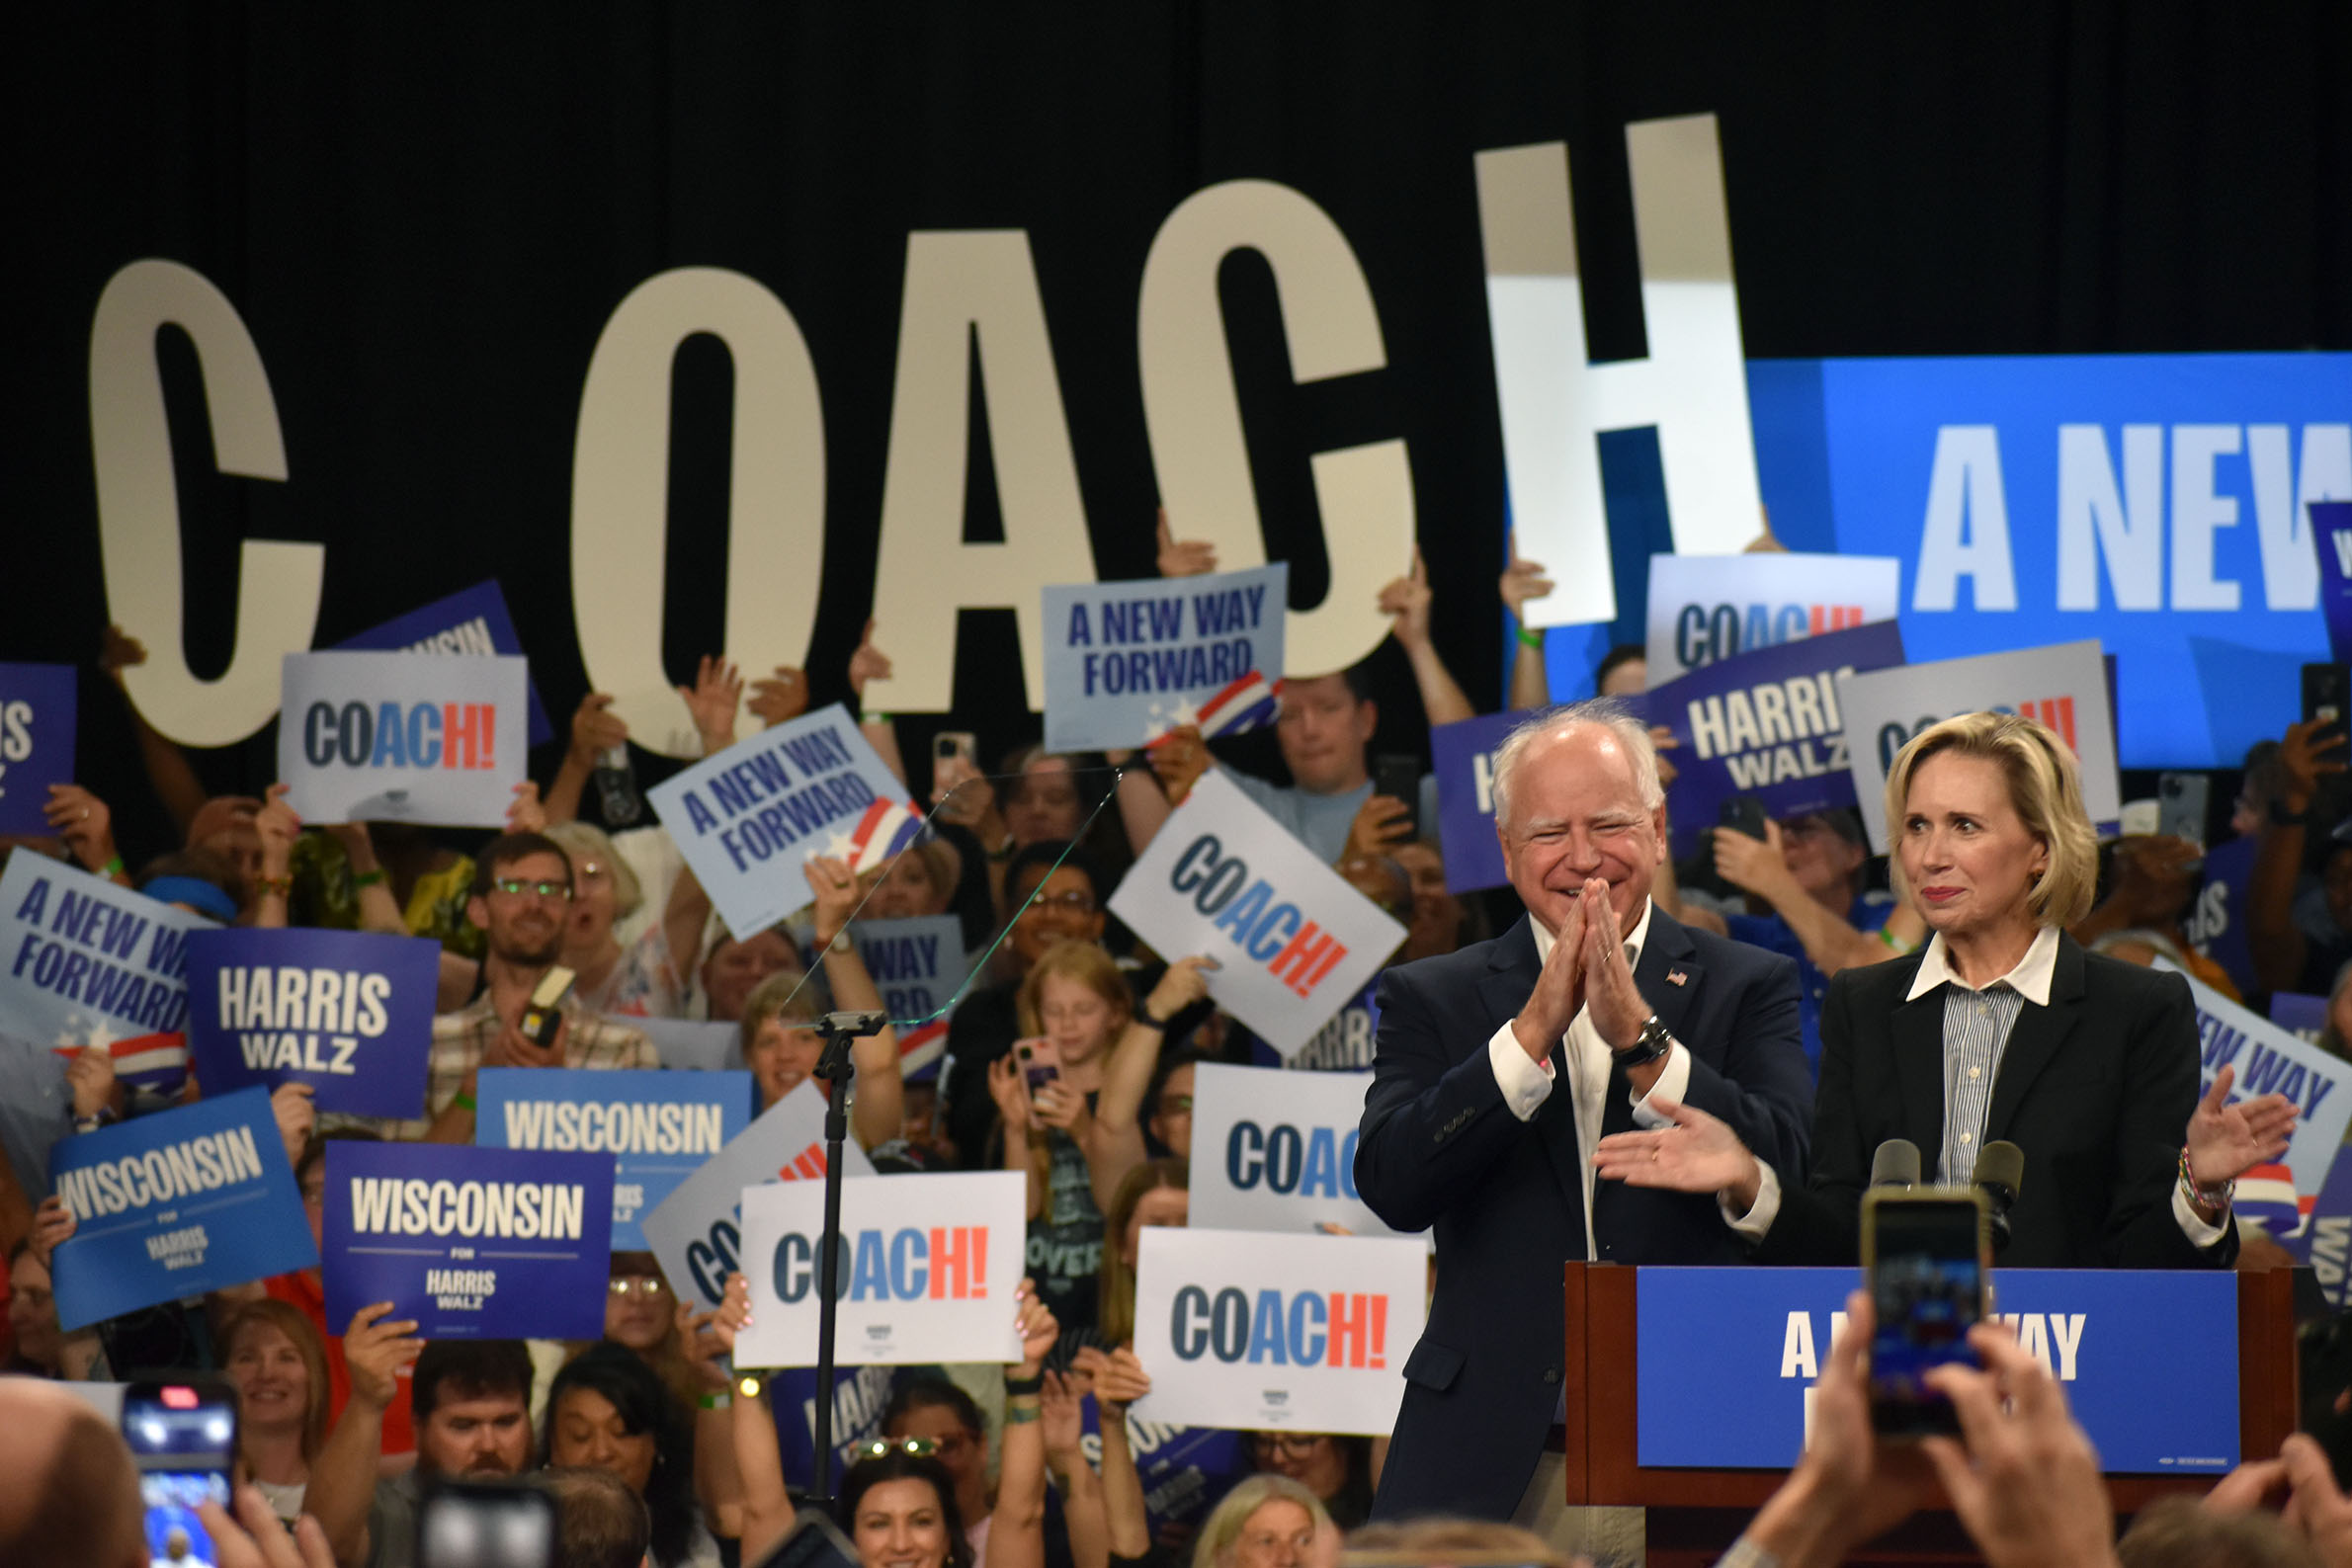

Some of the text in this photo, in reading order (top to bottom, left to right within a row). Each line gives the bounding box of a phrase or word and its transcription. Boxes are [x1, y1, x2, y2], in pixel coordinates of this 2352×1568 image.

[1912, 423, 2352, 612] A NEW
[1067, 584, 1266, 647] A NEW WAY
[1082, 638, 1253, 697] FORWARD
[303, 700, 496, 770] COACH!
[1688, 666, 1854, 761] HARRI
[681, 726, 854, 836] A NEW WAY
[1726, 737, 1851, 789] WALZ
[719, 771, 877, 873] FORWARD
[16, 876, 51, 926] A
[50, 889, 149, 961] NEW
[1169, 833, 1350, 1001] COACH!
[12, 932, 189, 1035] FORWARD
[217, 965, 391, 1037] HARRIS
[239, 1032, 359, 1075] WALZ
[2197, 1008, 2335, 1121] EW WAY
[504, 1100, 722, 1154] WISCONSIN
[55, 1124, 264, 1223] WISCONSIN
[350, 1177, 584, 1240] WISCONSIN
[425, 1268, 497, 1296] HARRIS
[450, 1247, 475, 1260] FOR
[772, 1225, 988, 1305] COACH!
[436, 1295, 483, 1310] WALZ
[1170, 1284, 1388, 1370] COACH!
[1781, 1311, 1818, 1378] A
